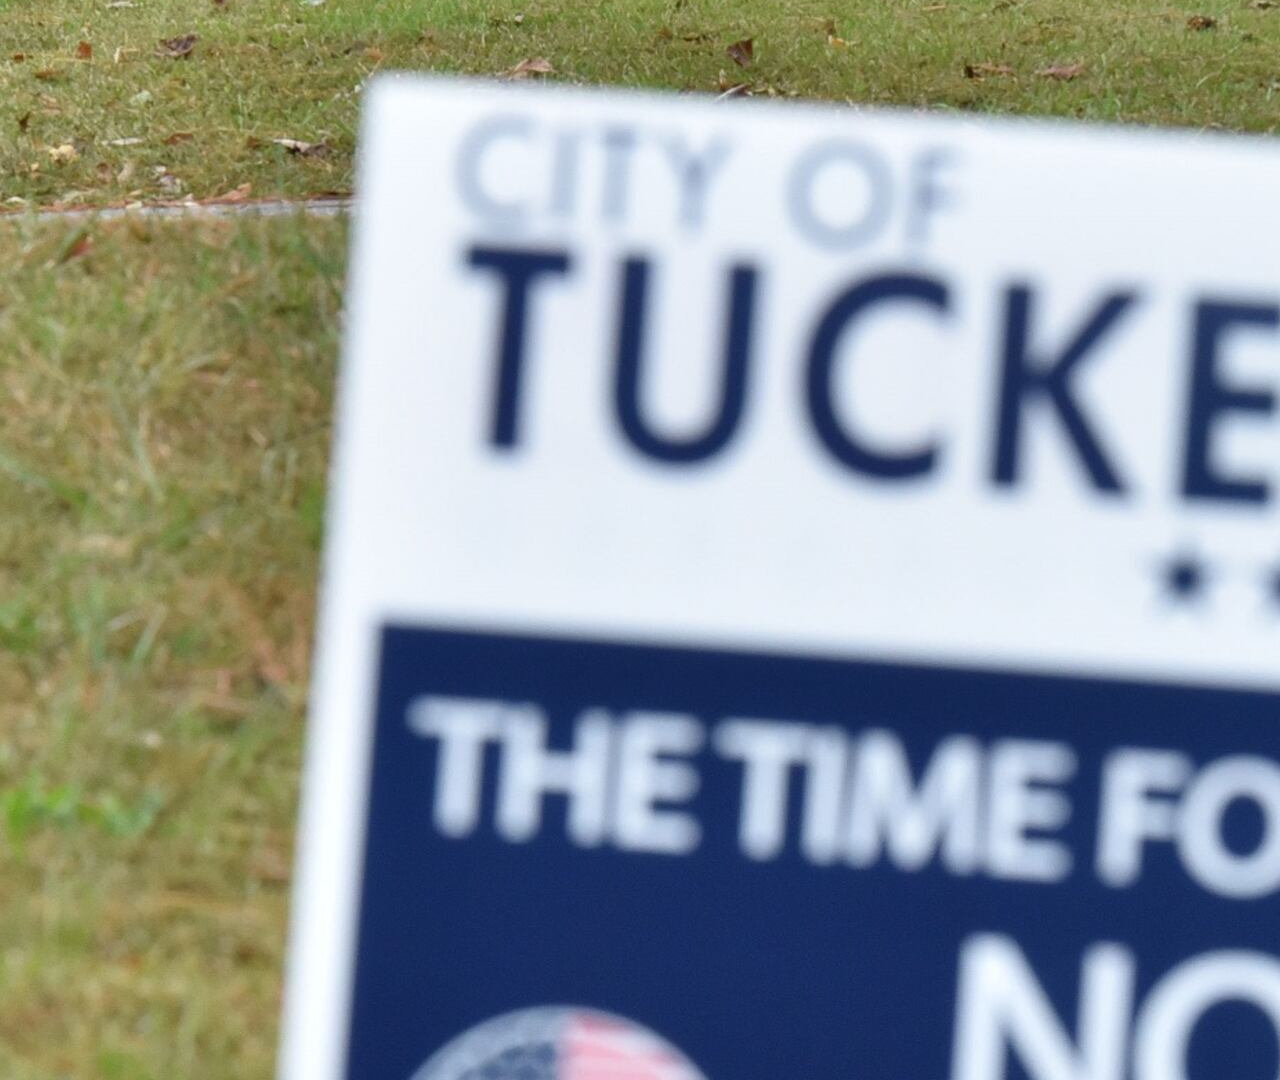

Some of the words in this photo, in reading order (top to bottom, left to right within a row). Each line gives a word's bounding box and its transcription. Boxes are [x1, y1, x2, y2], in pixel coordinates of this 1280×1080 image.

[454, 113, 736, 236] CITY
[786, 134, 966, 257] OF
[405, 692, 707, 857] THE
[710, 716, 1080, 886] TIME
